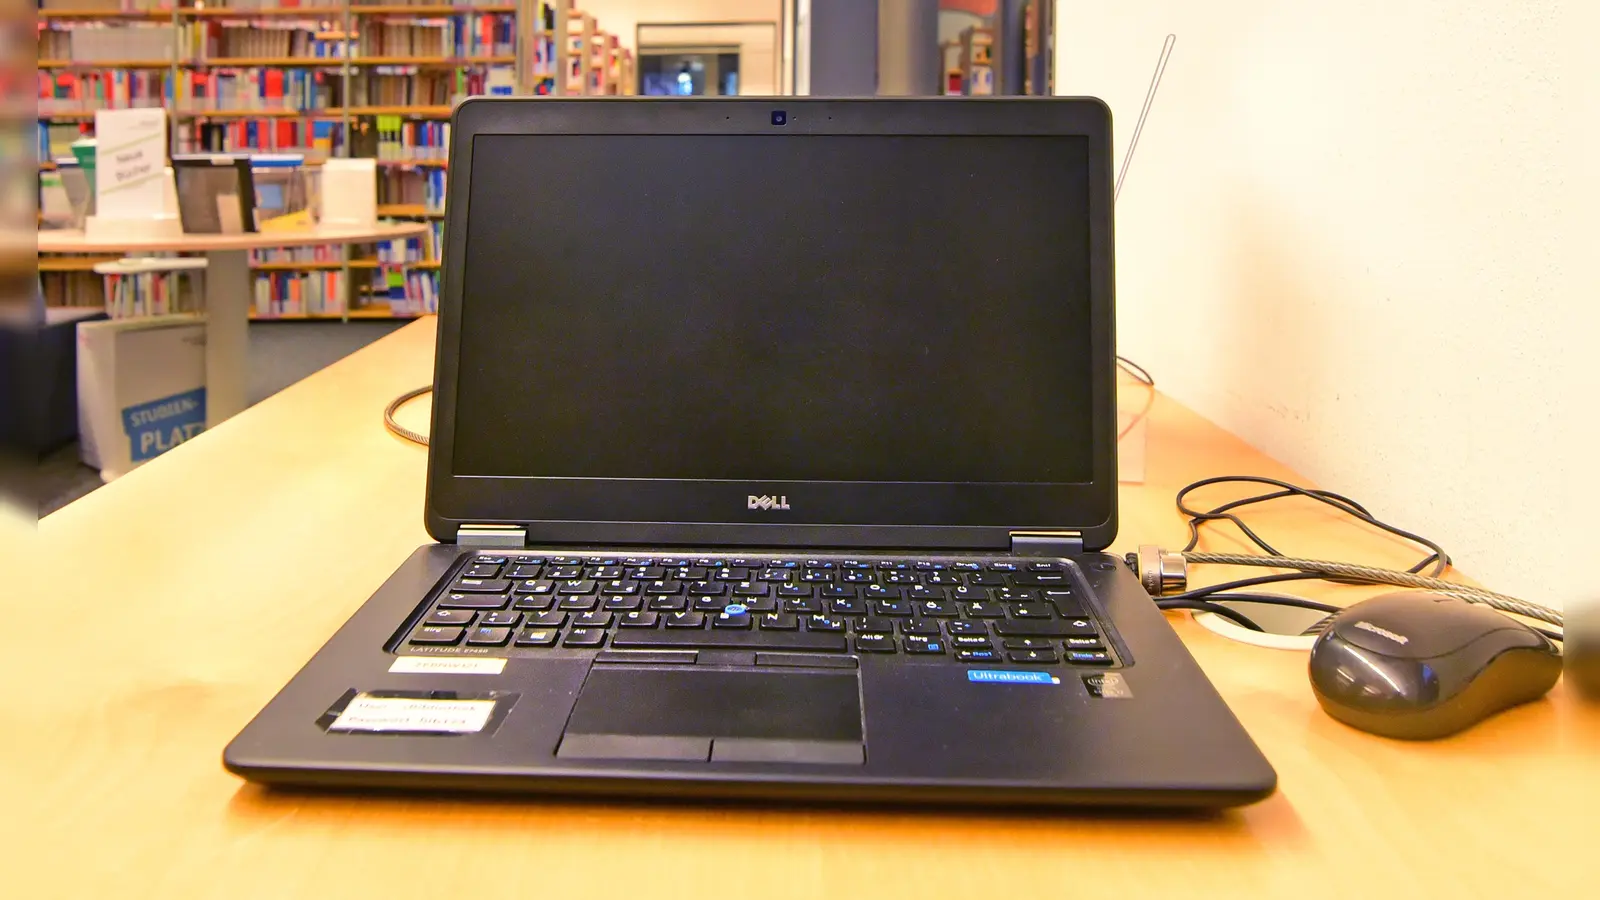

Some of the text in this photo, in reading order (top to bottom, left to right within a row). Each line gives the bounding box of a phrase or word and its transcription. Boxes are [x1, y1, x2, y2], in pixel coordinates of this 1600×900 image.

[748, 495, 790, 510] DELL
[1354, 621, 1409, 645] Microsoft
[973, 672, 1042, 682] Ultrabook
